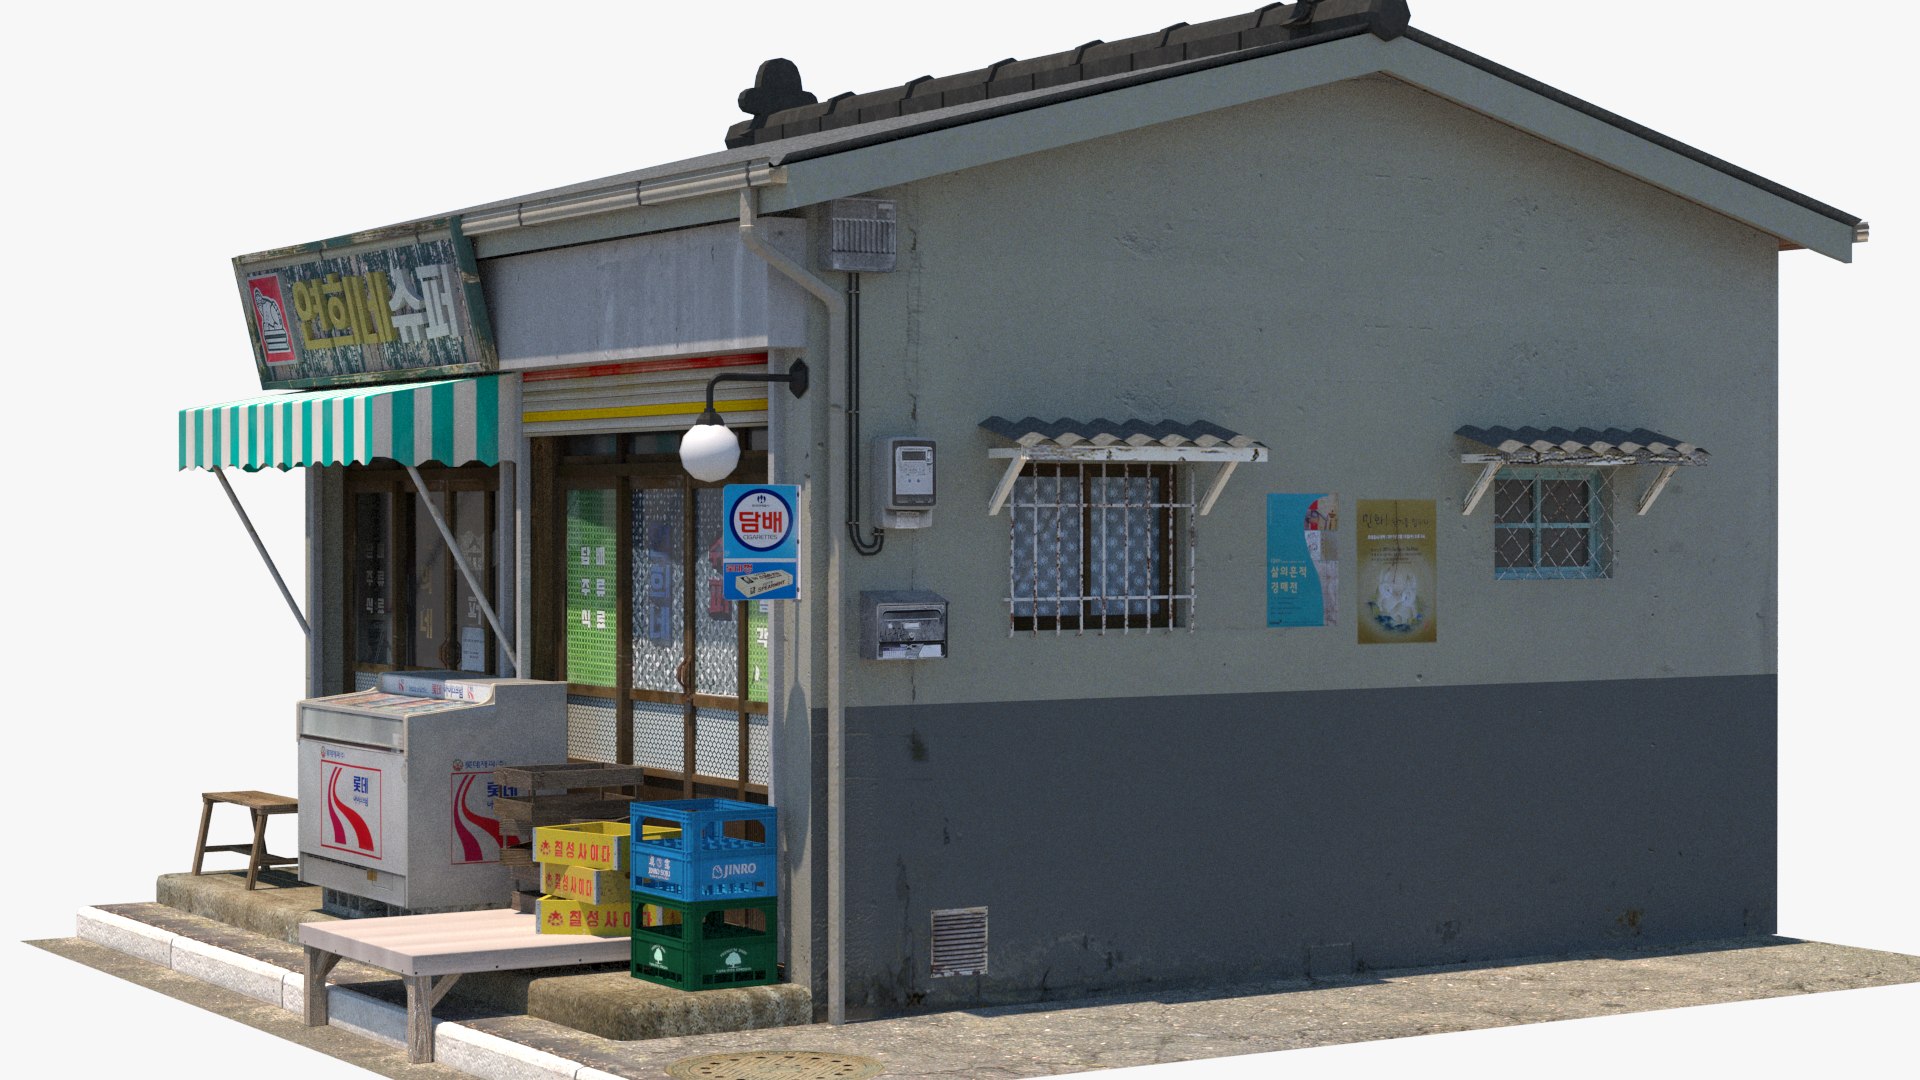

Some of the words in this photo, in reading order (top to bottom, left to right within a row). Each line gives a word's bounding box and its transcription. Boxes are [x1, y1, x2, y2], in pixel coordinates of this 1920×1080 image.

[739, 511, 783, 533] 담배
[1271, 581, 1298, 594] 경매전
[353, 775, 369, 794] 롯데
[554, 840, 611, 863] 칠성사이다
[724, 863, 757, 878] JINRO
[554, 873, 593, 897] 칠성사이다
